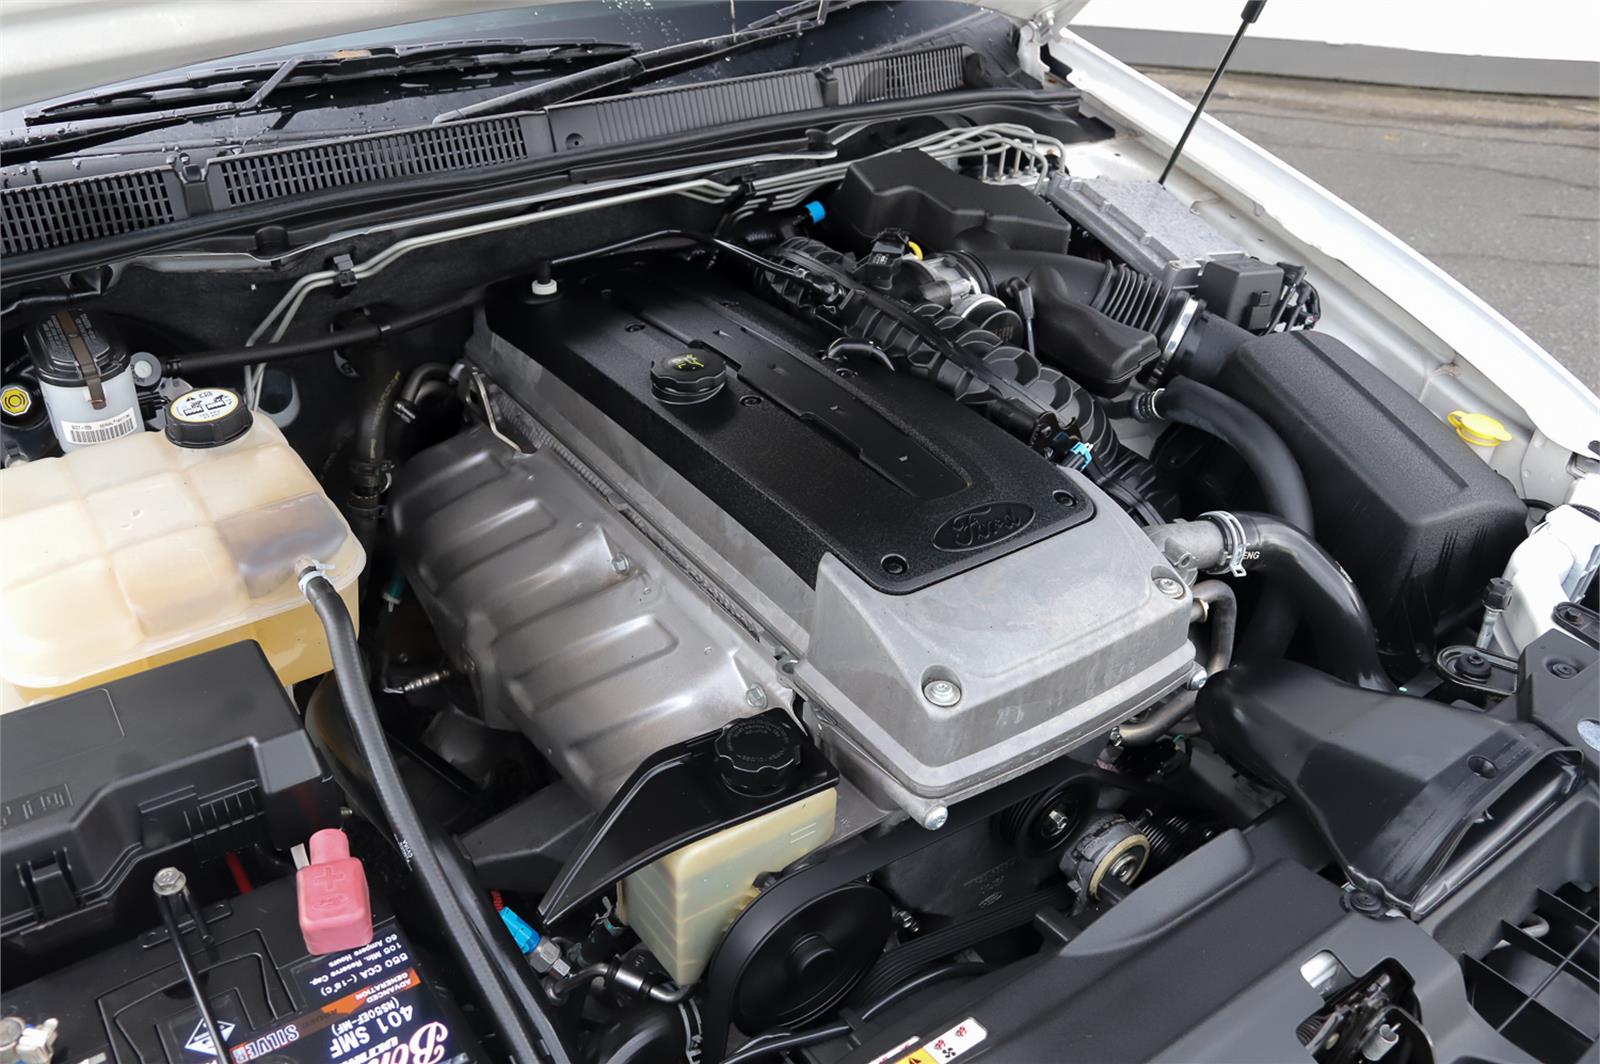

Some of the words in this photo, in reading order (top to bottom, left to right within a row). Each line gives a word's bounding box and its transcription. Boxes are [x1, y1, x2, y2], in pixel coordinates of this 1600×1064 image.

[951, 505, 1021, 547] Ford
[384, 934, 397, 943] 60
[354, 940, 383, 956] Ampere
[363, 950, 383, 961] Min.
[383, 942, 402, 954] 105
[328, 954, 352, 967] Hours
[330, 960, 363, 977] Reserve
[384, 953, 408, 967] 550
[359, 964, 383, 979] CCA
[354, 972, 408, 1000] GENERATION
[366, 978, 411, 1003] ADVANCED
[331, 996, 400, 1037] (NS50EF-MF)
[376, 1004, 413, 1034] 401
[232, 1024, 299, 1063] SILVER
[329, 1026, 370, 1058] SMF
